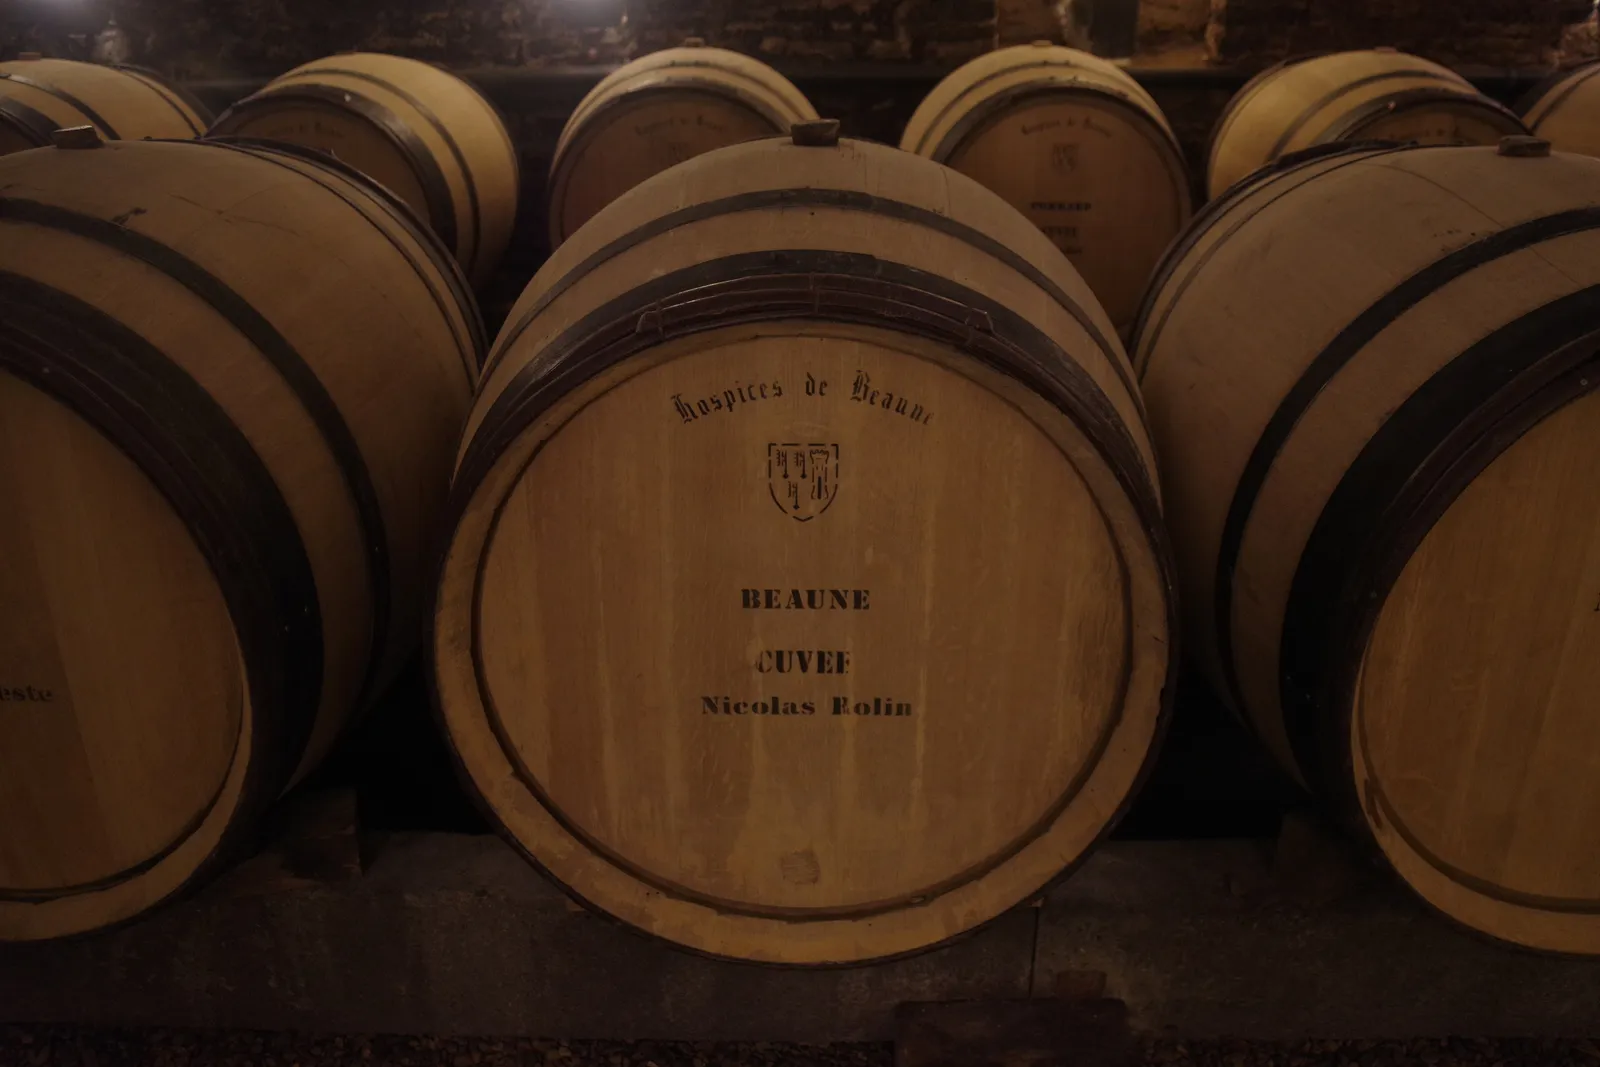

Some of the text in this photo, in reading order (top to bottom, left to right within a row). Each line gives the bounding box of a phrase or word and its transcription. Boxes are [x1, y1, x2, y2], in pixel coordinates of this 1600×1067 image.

[671, 369, 935, 425] Hospices de Beaune
[741, 588, 870, 609] BEAUNE
[701, 695, 912, 717] Nicolas Rolin
